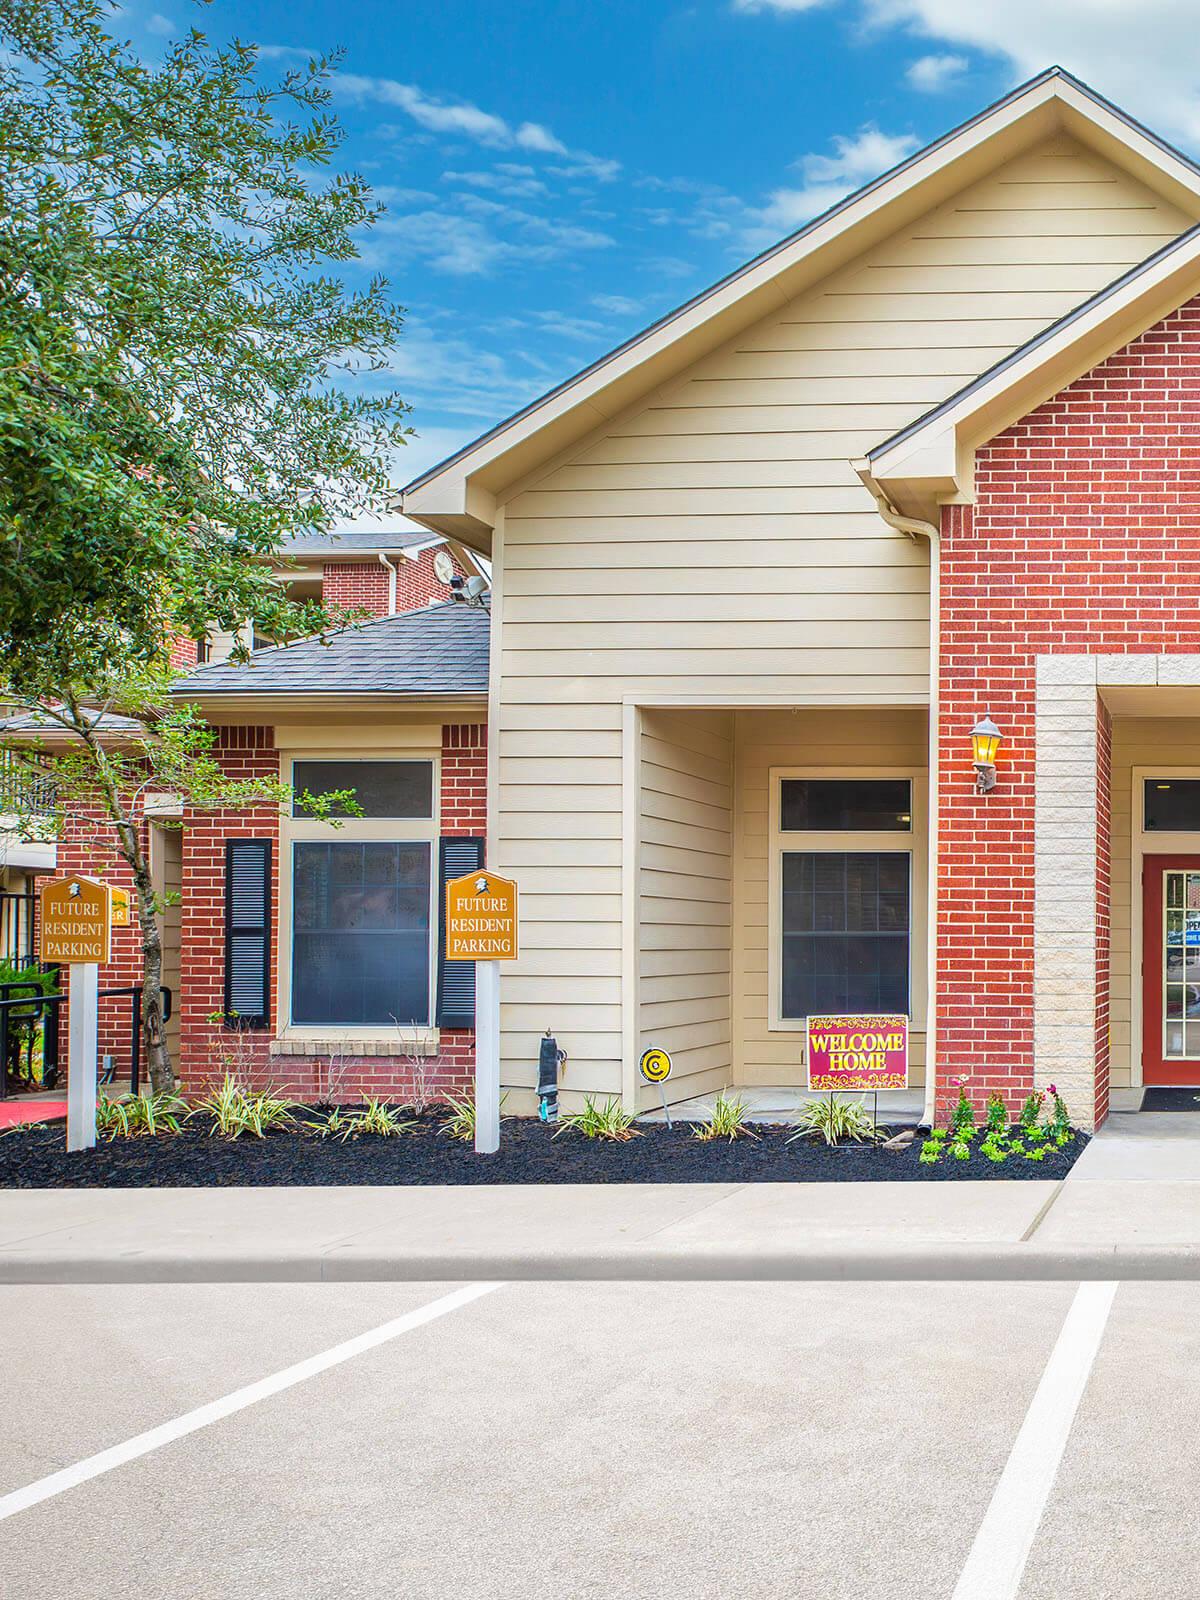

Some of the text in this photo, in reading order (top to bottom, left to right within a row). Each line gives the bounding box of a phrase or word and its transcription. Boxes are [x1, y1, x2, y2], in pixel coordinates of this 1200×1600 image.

[50, 902, 99, 916] FUTURE
[457, 898, 508, 911] FUTURE
[44, 922, 104, 936] RESIDENT
[451, 918, 512, 932] RESIDENT
[47, 941, 101, 956] PARKING
[453, 938, 511, 952] PARKING
[810, 1033, 904, 1053] WELCOME
[828, 1052, 887, 1071] HOME
